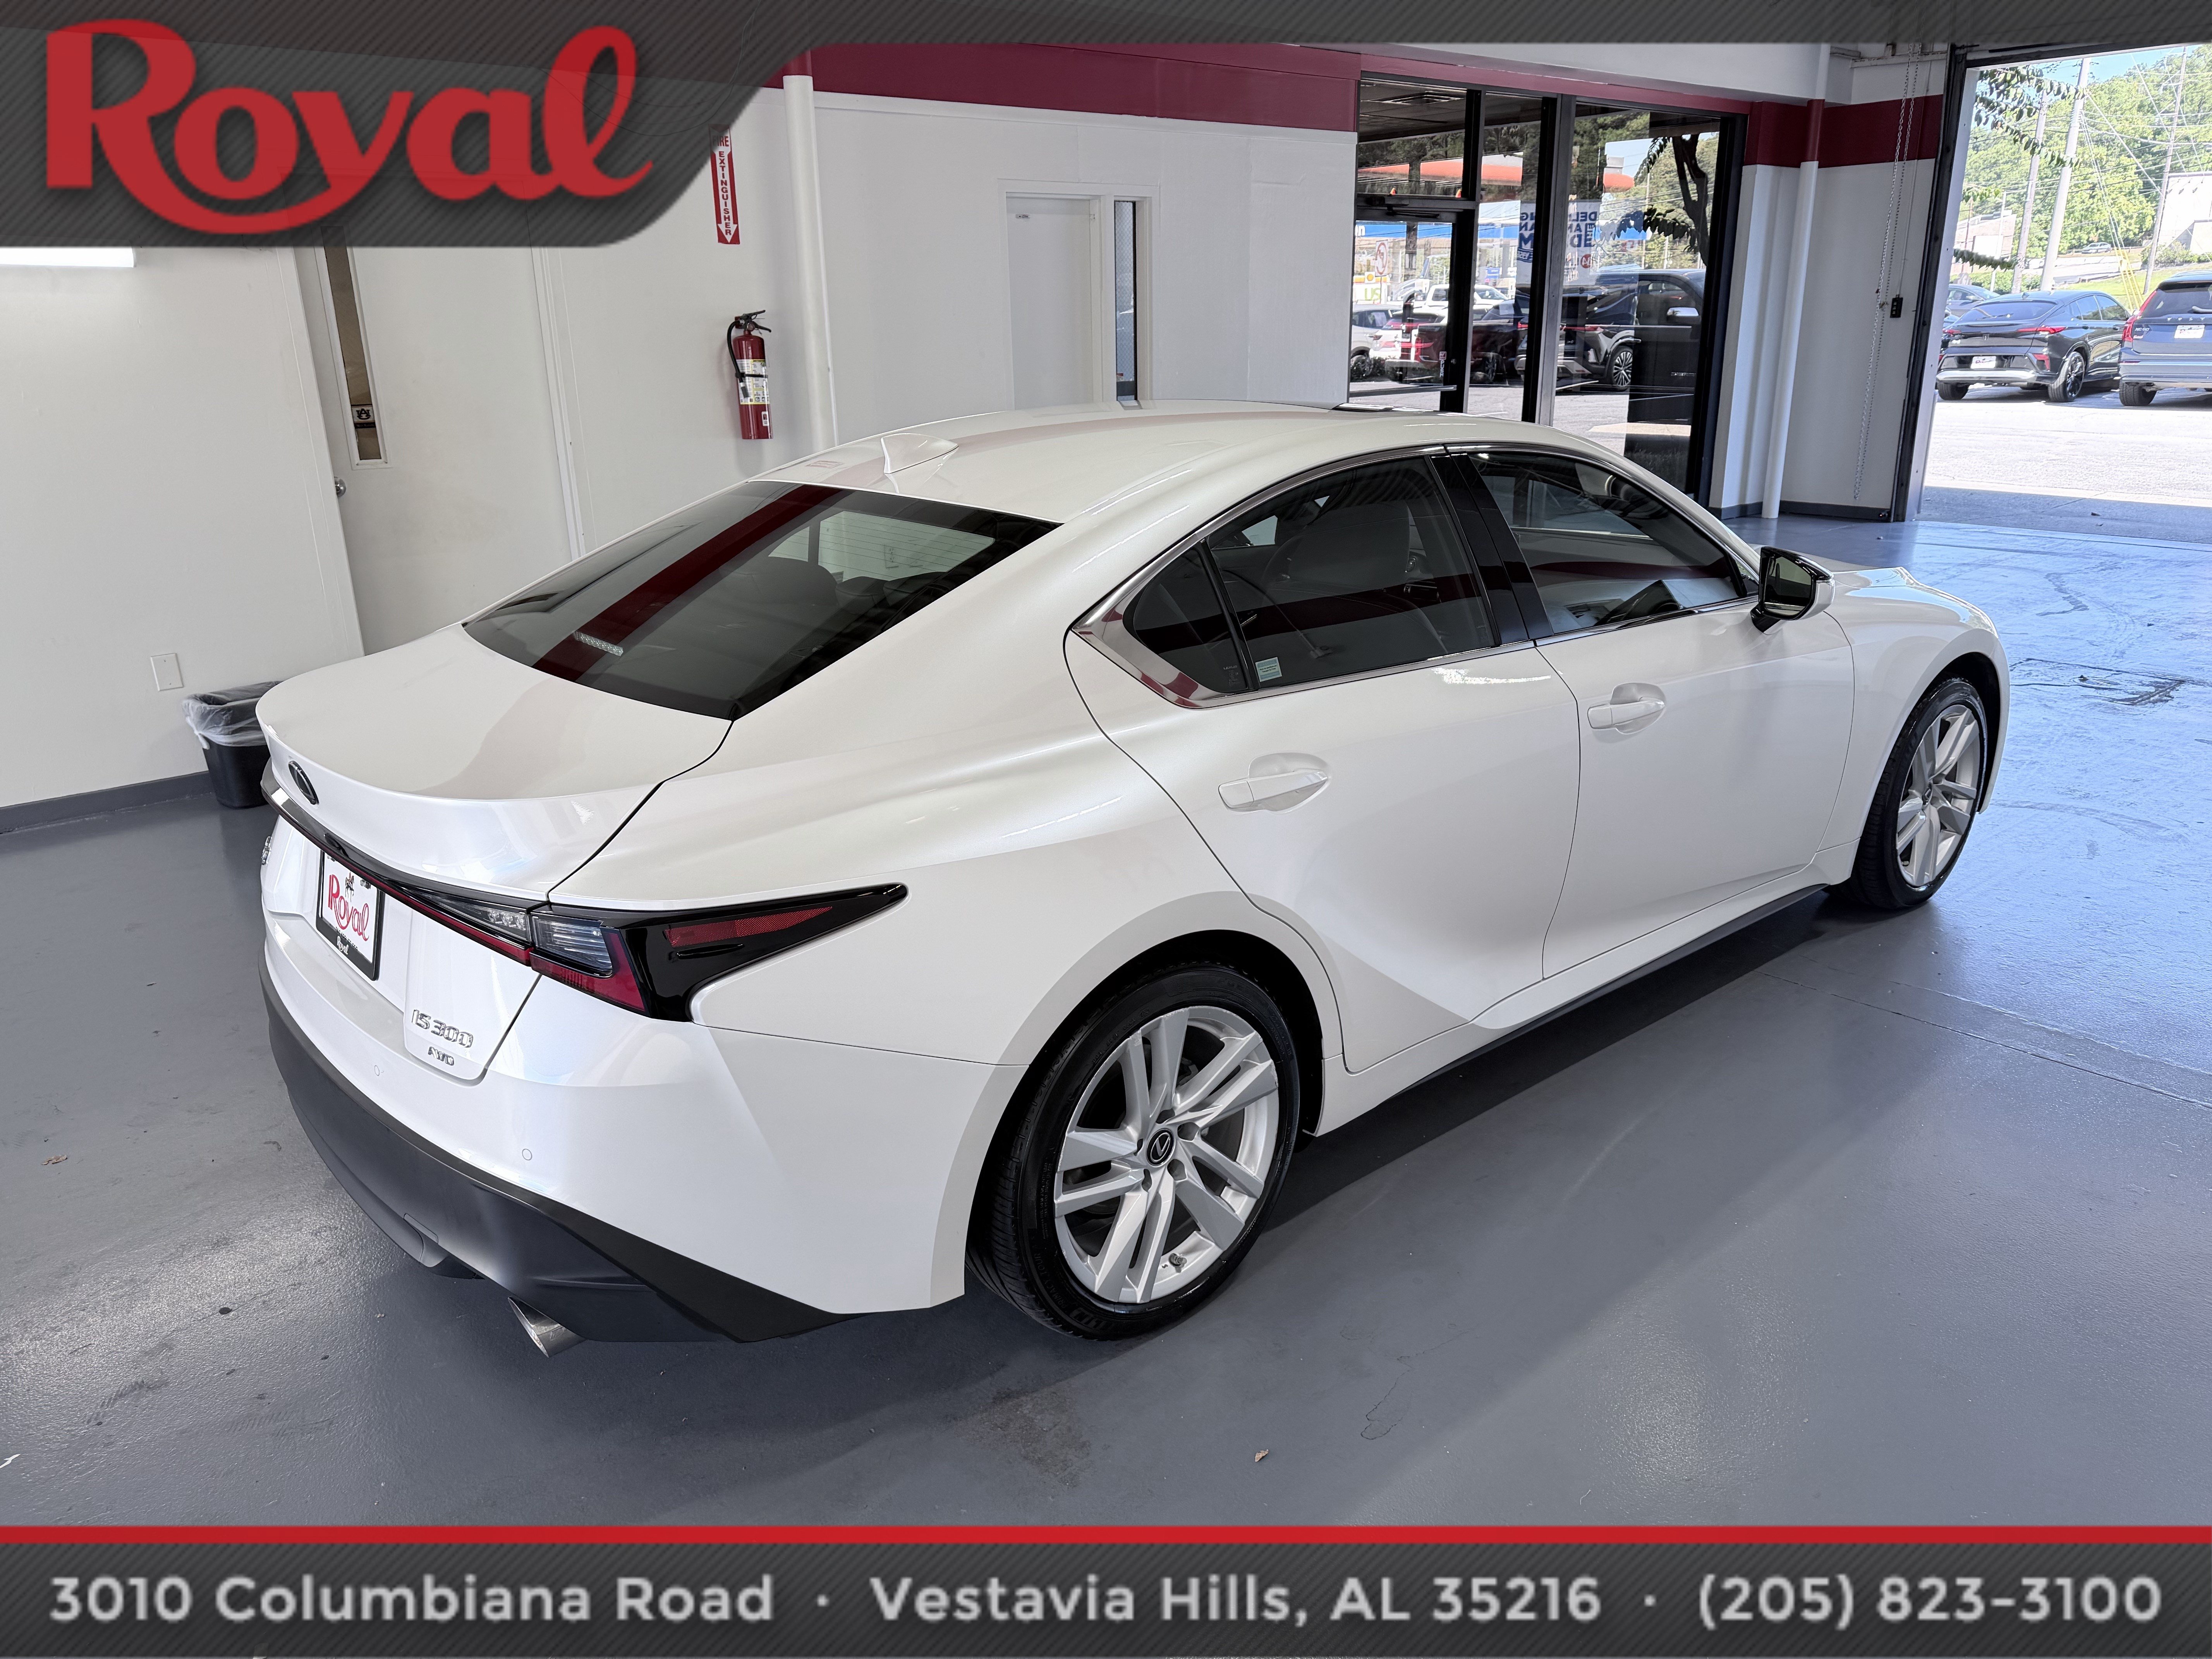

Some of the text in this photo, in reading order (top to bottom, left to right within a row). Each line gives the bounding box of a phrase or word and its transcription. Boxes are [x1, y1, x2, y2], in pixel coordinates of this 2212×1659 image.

[719, 151, 732, 236] EXTINGUISHER
[328, 874, 369, 941] Royal
[337, 936, 349, 955] Royal
[411, 1009, 474, 1048] IS 300
[428, 1046, 454, 1066] AWD
